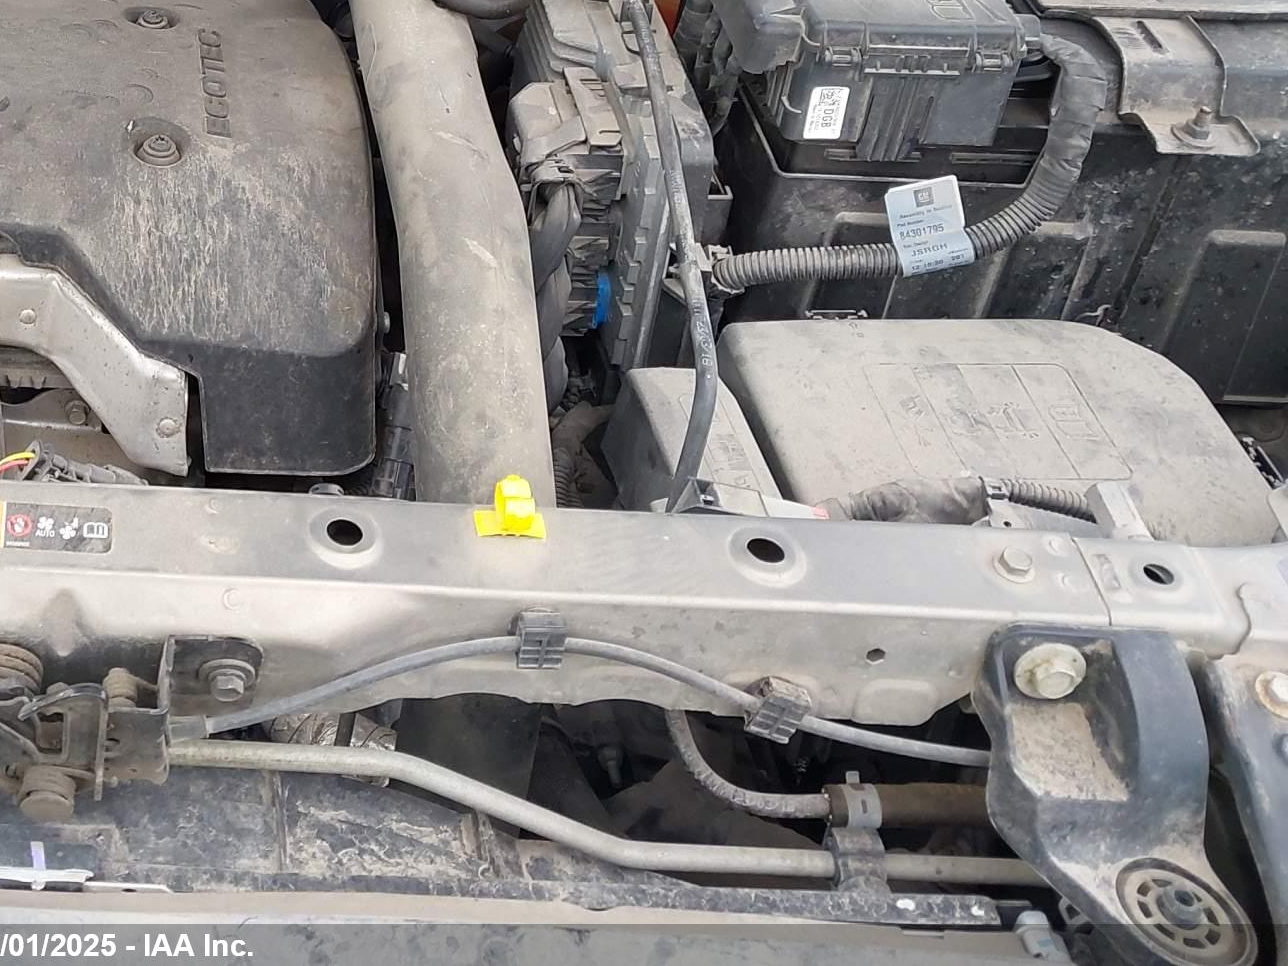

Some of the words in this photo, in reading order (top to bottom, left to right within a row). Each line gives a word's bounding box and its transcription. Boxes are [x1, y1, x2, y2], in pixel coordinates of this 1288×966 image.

[196, 27, 233, 139] ECOTEC
[899, 224, 944, 241] 84301795
[35, 529, 55, 538] AUTO
